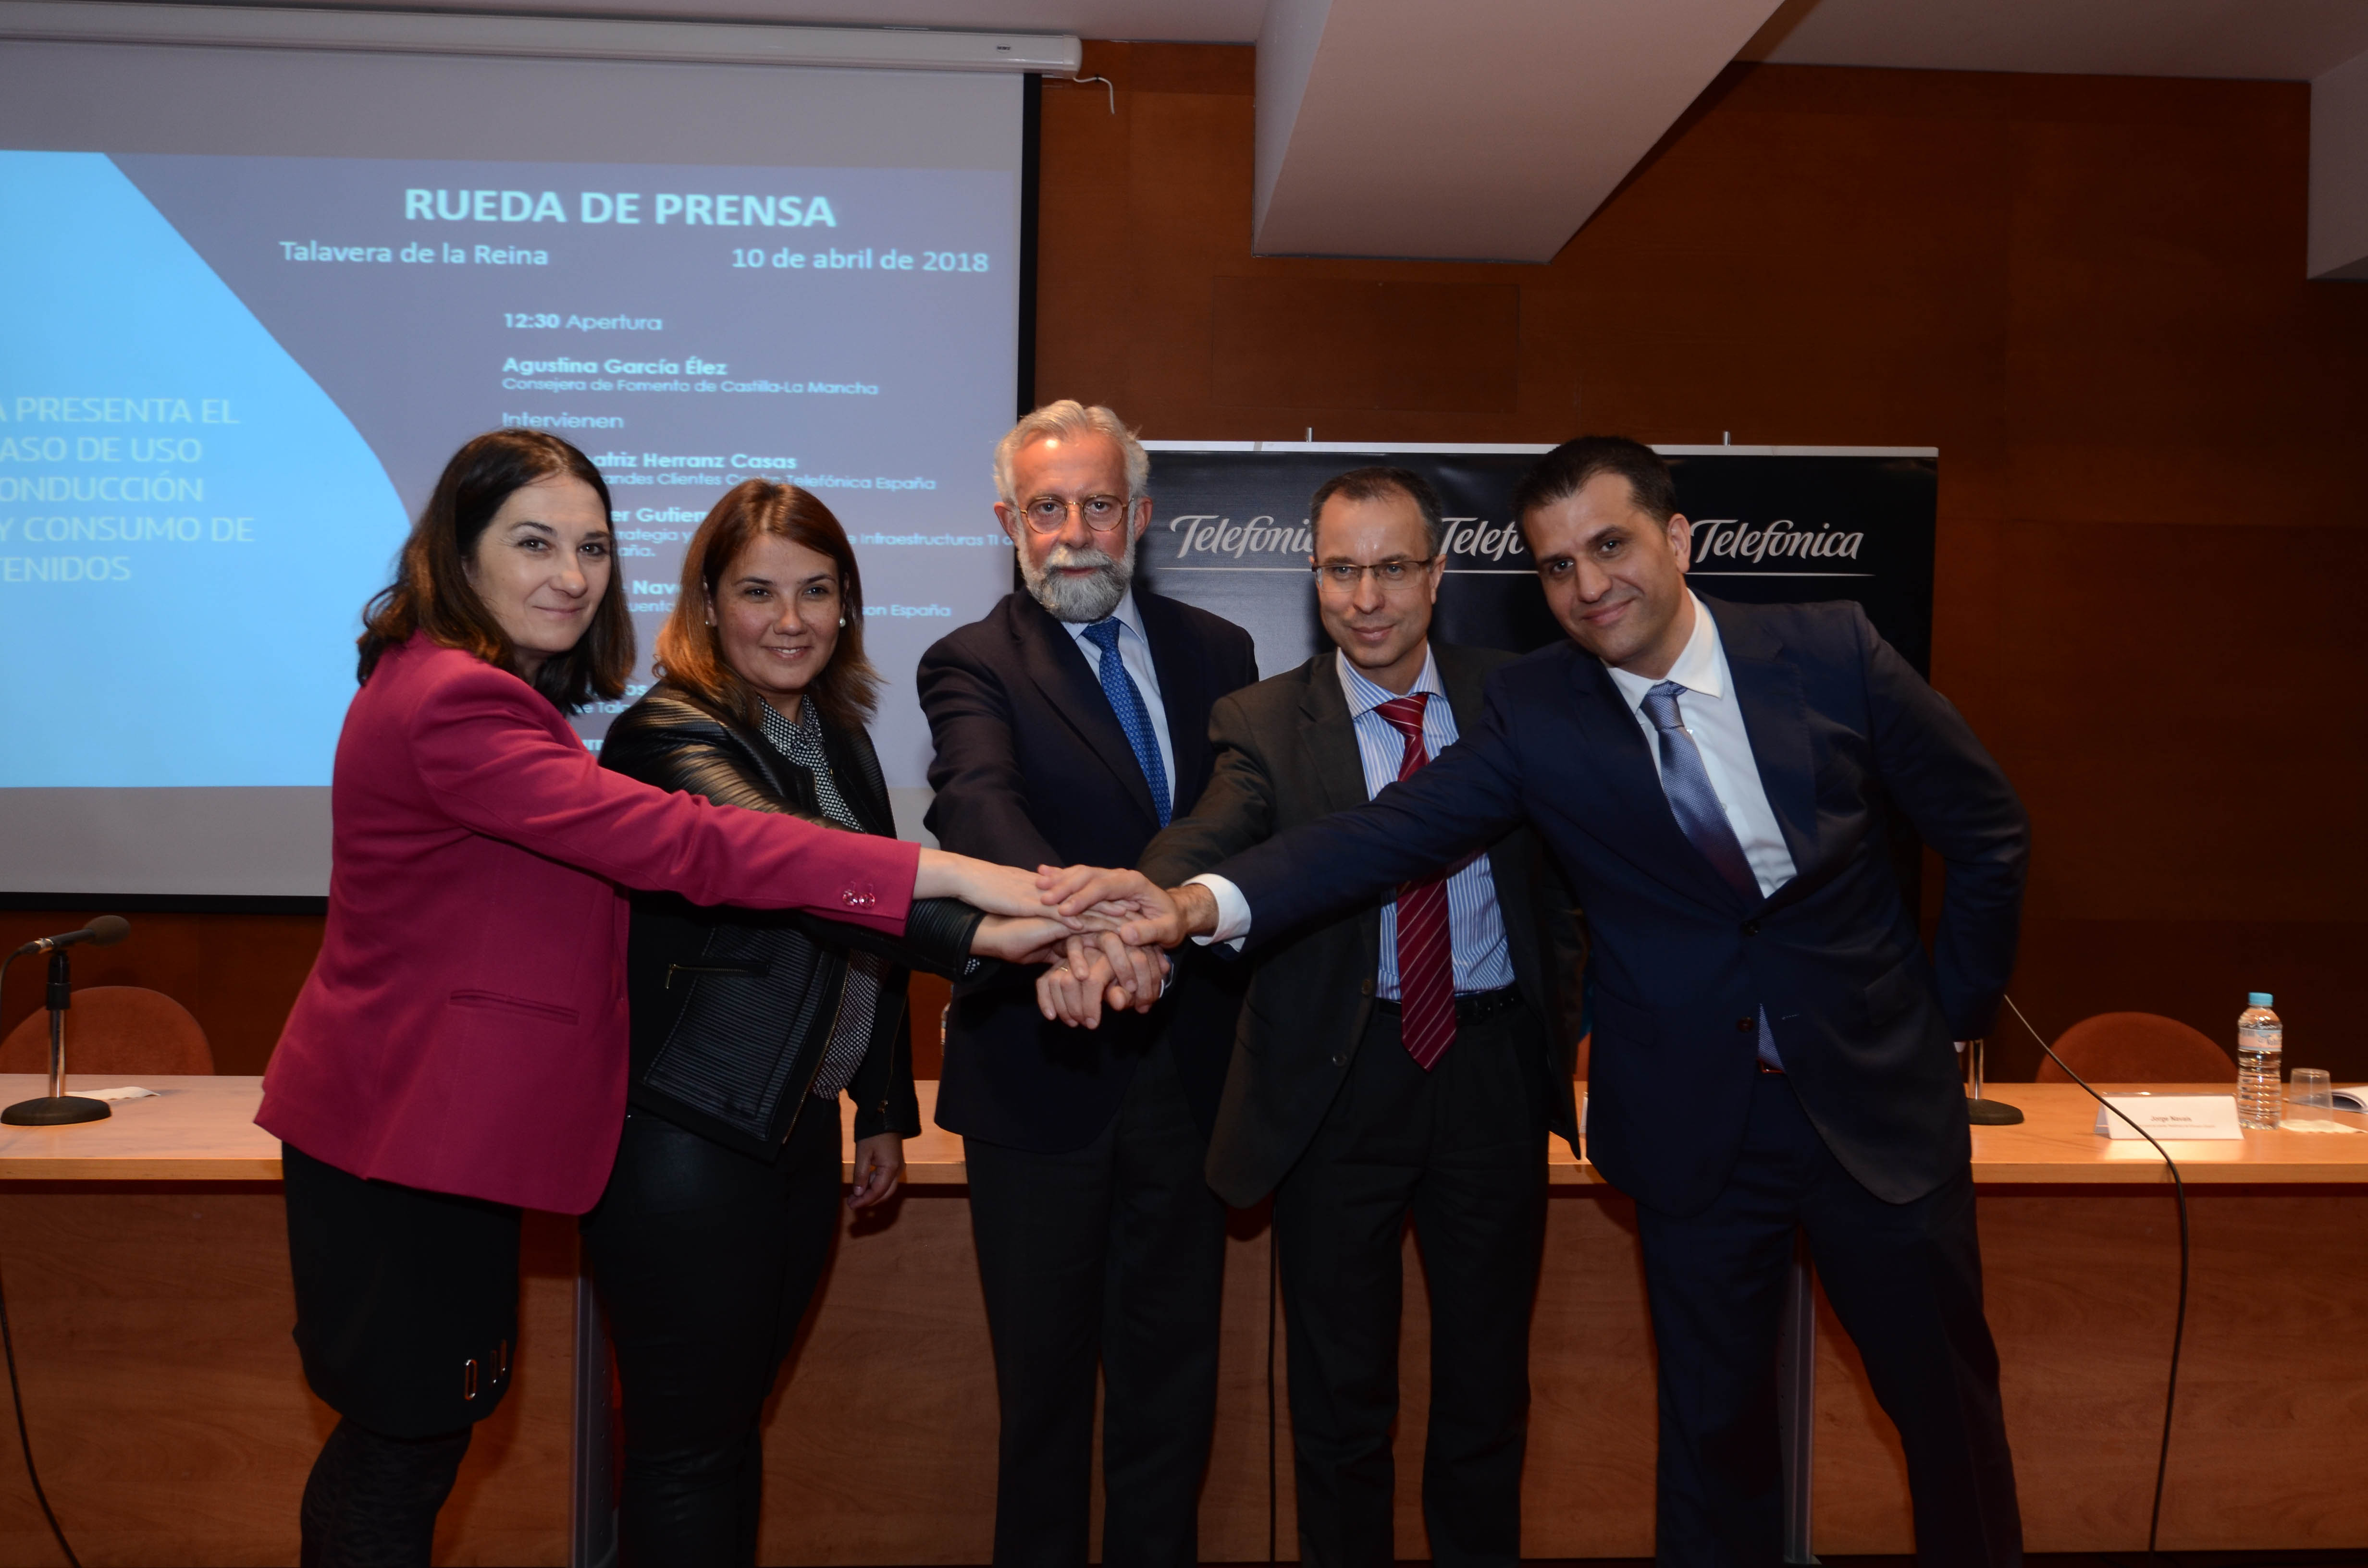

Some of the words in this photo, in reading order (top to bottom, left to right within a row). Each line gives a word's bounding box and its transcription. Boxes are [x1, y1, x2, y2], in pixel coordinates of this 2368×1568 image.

[405, 188, 567, 222] RUEDA
[580, 192, 641, 224] DE
[655, 193, 837, 227] PRENSA
[279, 240, 392, 262] Talavera
[400, 241, 435, 263] de
[443, 242, 466, 263] la
[474, 244, 548, 266] Reina
[731, 248, 765, 268] 10
[772, 247, 805, 268] de
[814, 247, 872, 269] abril
[880, 248, 913, 270] de
[922, 251, 989, 272] 2018
[504, 313, 560, 329] 12:30
[566, 314, 662, 332] Apertura
[502, 357, 598, 376] Agustina
[604, 358, 678, 375] García
[685, 355, 728, 375] Élez
[502, 378, 587, 393] Consejera
[590, 379, 613, 391] de
[617, 380, 690, 392] Fomento
[694, 379, 717, 392] de
[721, 380, 804, 393] Castilla-La
[808, 381, 879, 395] Mancha
[16, 397, 193, 423] PRESENTA
[201, 399, 240, 424] EL
[502, 411, 624, 429] Intervienen
[76, 437, 122, 462] DE
[131, 437, 202, 463] USO
[643, 453, 725, 468] Herranz
[730, 453, 797, 469] Casas
[657, 473, 720, 485] Clientes
[876, 477, 936, 492] España
[24, 516, 200, 542] CONSUMO
[211, 517, 255, 542] DE
[860, 532, 983, 546] Infraestructuras
[891, 603, 951, 618] España
